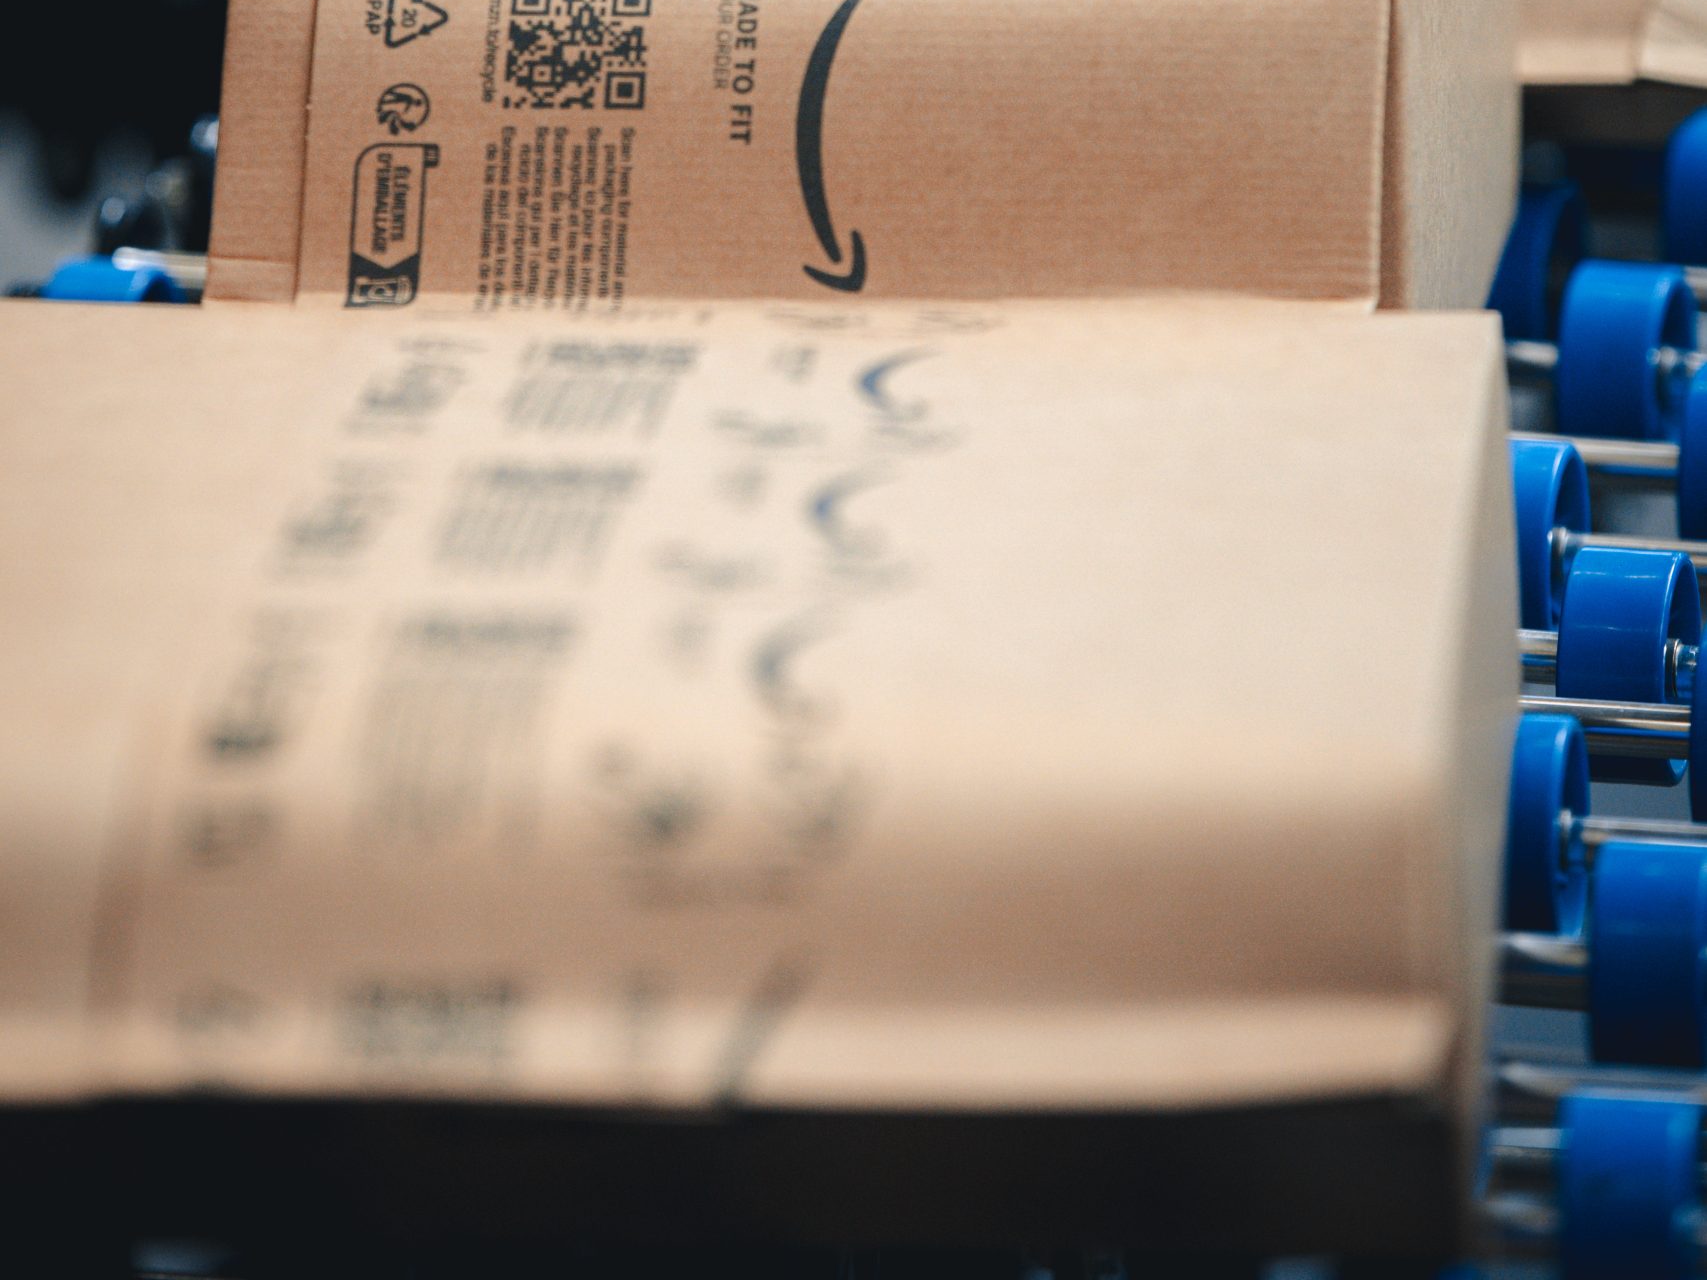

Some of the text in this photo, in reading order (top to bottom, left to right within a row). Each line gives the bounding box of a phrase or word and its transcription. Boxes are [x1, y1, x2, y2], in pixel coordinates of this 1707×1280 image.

[365, 0, 382, 35] PAP
[402, 9, 417, 28] 20
[713, 30, 733, 90] ORDER
[732, 59, 756, 94] TO
[730, 104, 753, 145] FIT
[621, 127, 635, 161] Scan
[620, 167, 632, 196] here
[372, 153, 392, 253] D'EMBALLAGE
[391, 166, 412, 241] ÉLÉMENTS
[618, 202, 631, 217] for
